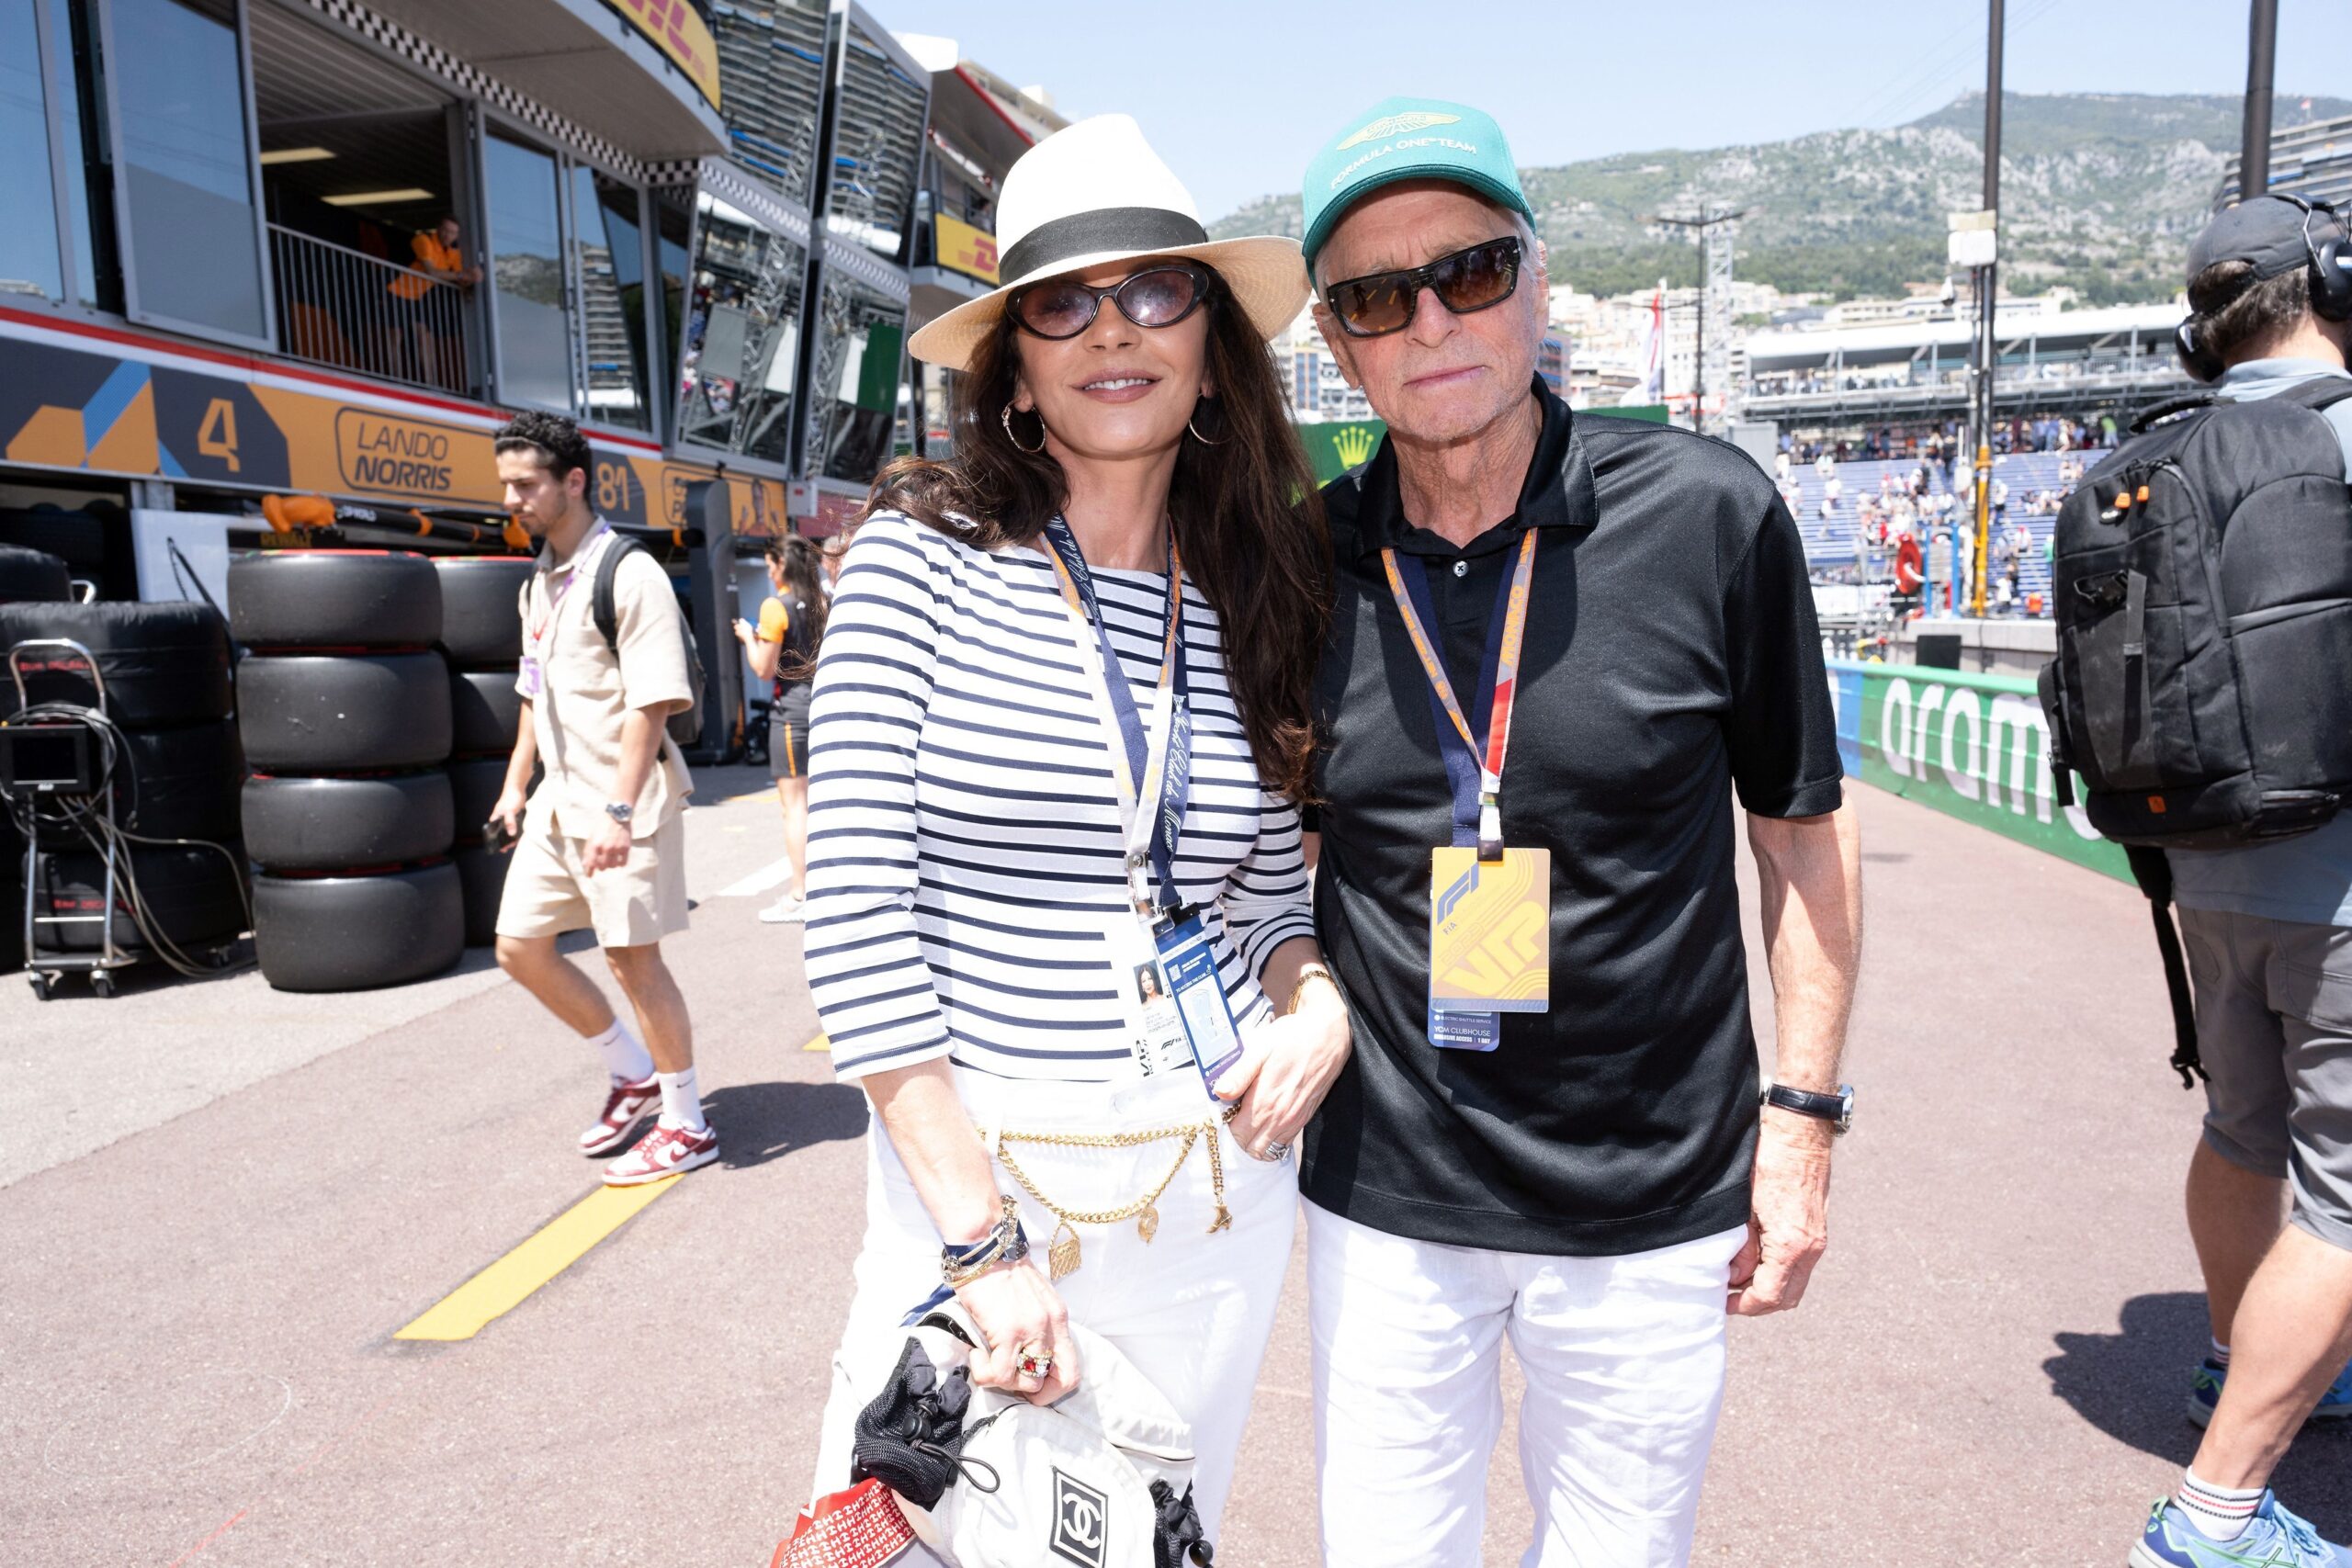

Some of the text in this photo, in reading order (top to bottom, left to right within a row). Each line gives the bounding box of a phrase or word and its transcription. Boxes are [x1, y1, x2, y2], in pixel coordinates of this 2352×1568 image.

[1330, 144, 1394, 190] FORMULA
[1437, 139, 1477, 154] TEAM
[198, 397, 241, 472] 4
[357, 421, 448, 461] LANDO
[355, 455, 452, 491] NORRIS
[597, 462, 630, 512] 81
[1500, 585, 1523, 667] MONACO
[1167, 748, 1188, 787] Club
[1165, 781, 1180, 802] de
[1440, 921, 1486, 964] 2023
[1442, 900, 1547, 997] VIP
[1433, 1025, 1491, 1037] YCM CLUBHOUSE
